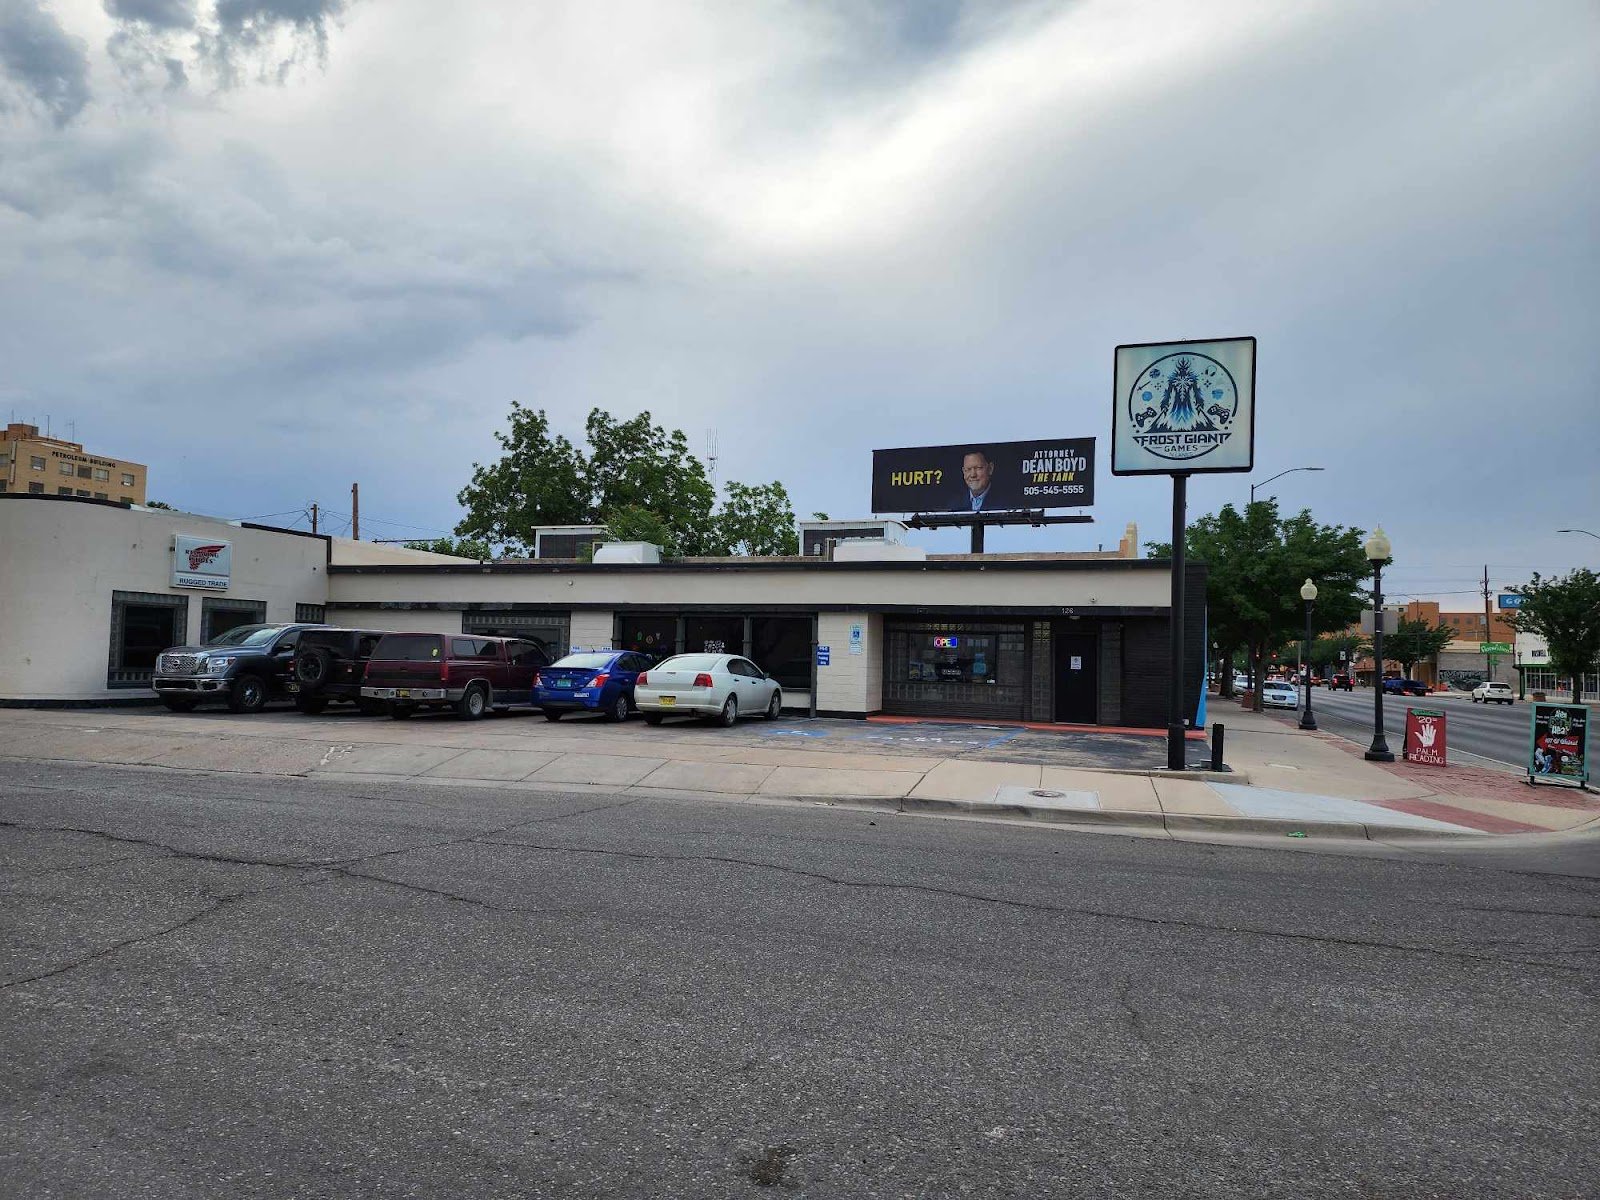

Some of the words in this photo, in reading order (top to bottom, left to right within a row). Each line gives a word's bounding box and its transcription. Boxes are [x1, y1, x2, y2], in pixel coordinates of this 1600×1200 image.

[1133, 434, 1181, 446] FROST
[1184, 433, 1232, 444] GIANT
[1034, 449, 1075, 459] ATTORNEY
[1164, 444, 1198, 452] GAMES
[51, 451, 87, 462] PETROLEUM
[89, 458, 116, 468] BUILDING
[1022, 457, 1051, 474] DEAN
[1055, 456, 1087, 472] BOYD
[891, 469, 943, 486] HURT?
[1032, 473, 1049, 483] THE
[1052, 472, 1075, 482] TANK
[1023, 484, 1084, 496] 505-545-5555
[180, 577, 207, 586] RUGGED
[208, 580, 228, 588] TRADE
[1416, 747, 1438, 757] PALM
[1409, 753, 1444, 765] READING
